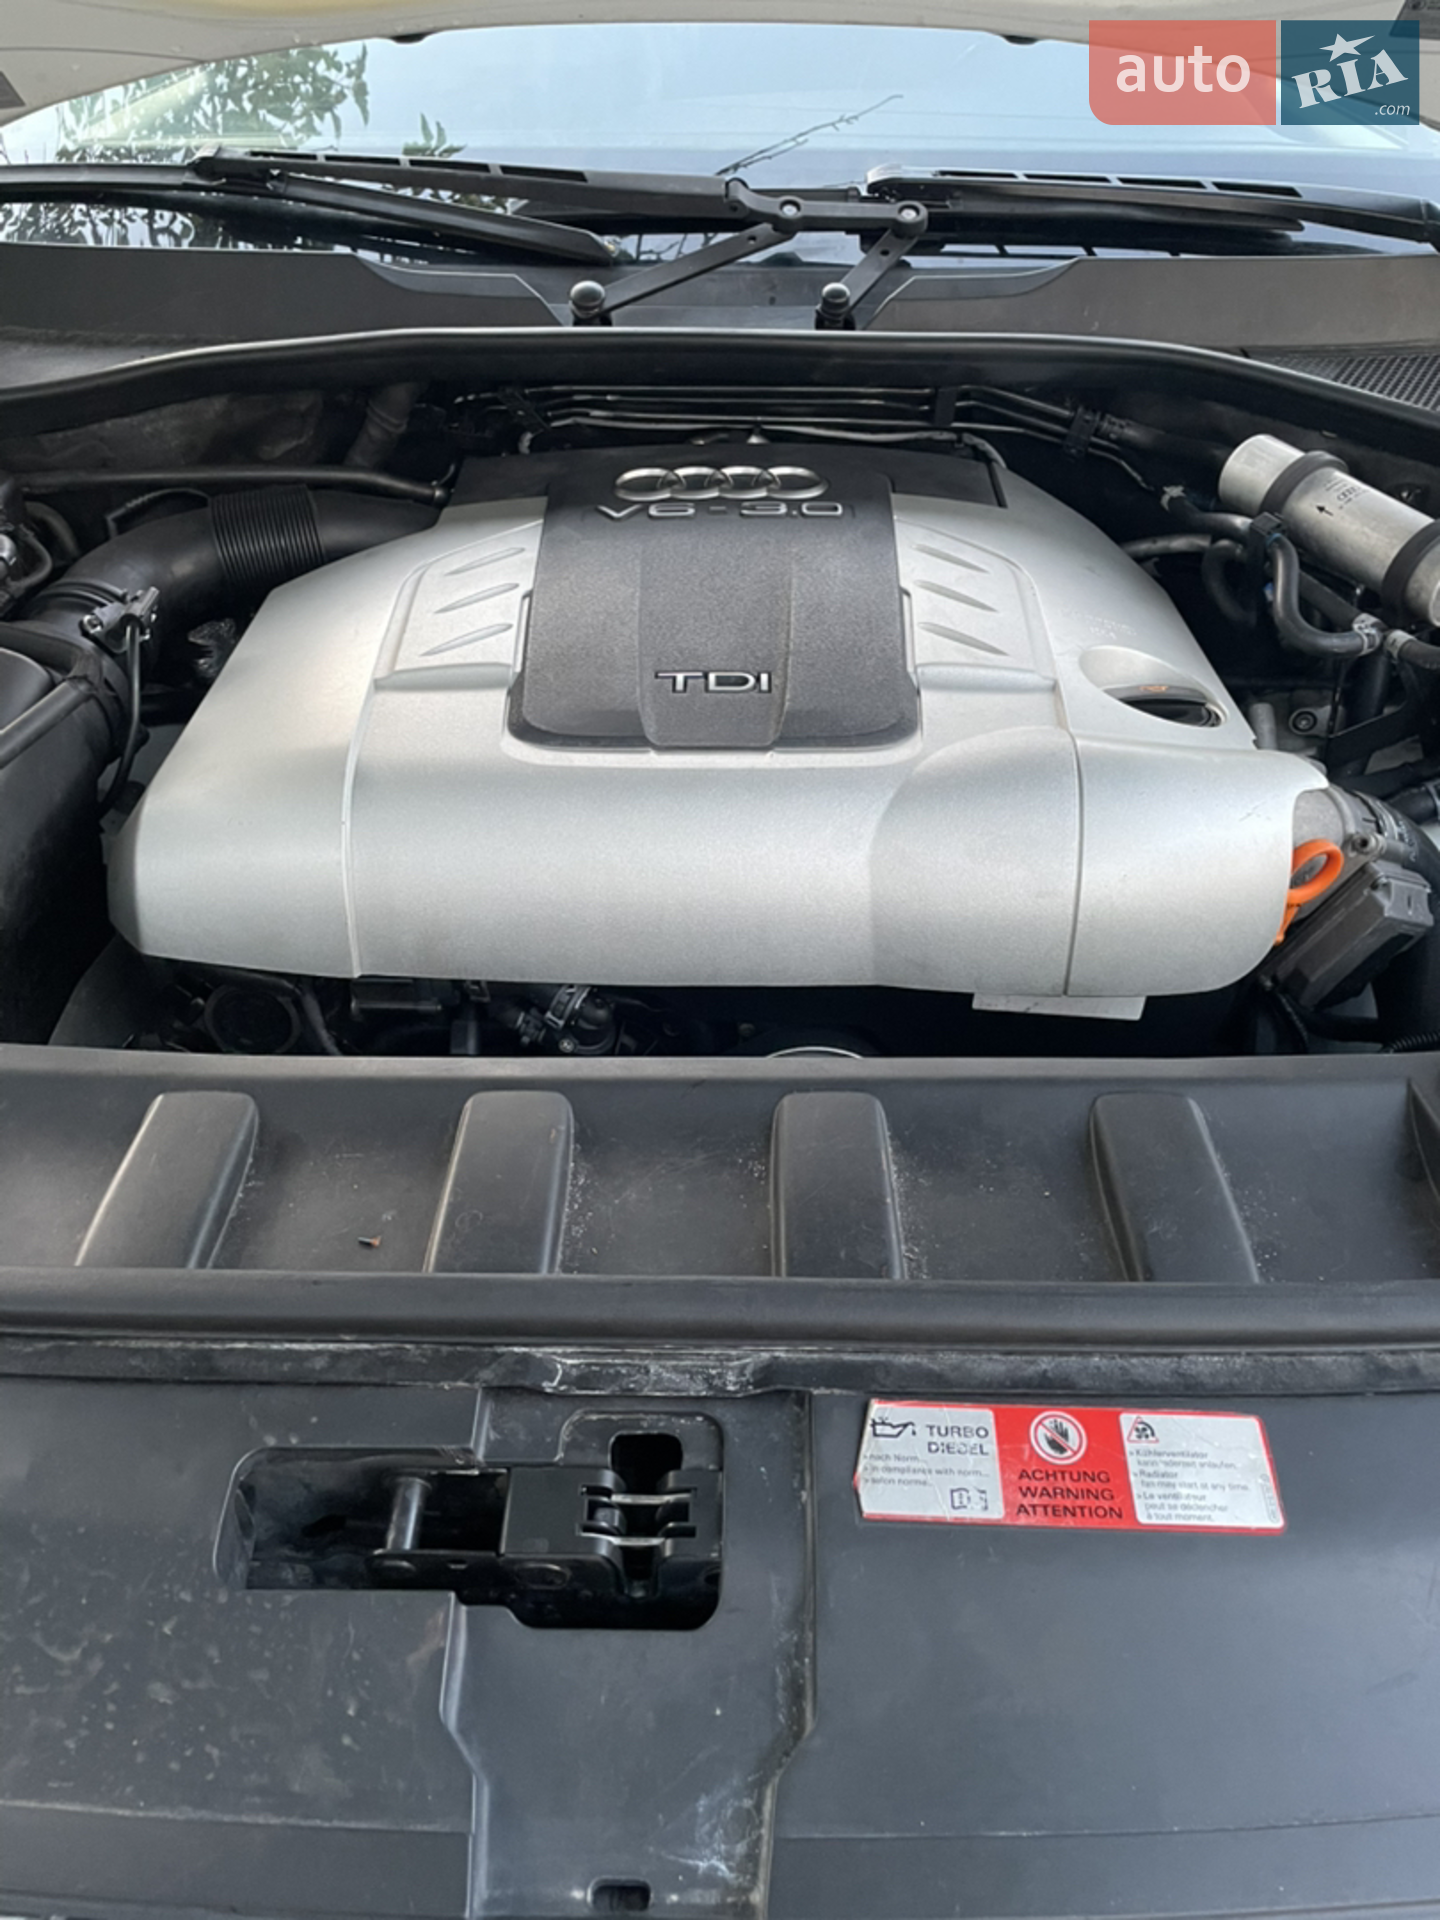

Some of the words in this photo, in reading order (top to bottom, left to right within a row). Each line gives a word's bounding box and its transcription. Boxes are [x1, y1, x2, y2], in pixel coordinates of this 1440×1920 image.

[655, 671, 772, 693] TDI
[926, 1424, 989, 1439] TURBO
[927, 1441, 989, 1456] DIESEL
[1018, 1468, 1111, 1484] ACHTUNG
[1138, 1469, 1178, 1478] Radiator
[1018, 1486, 1115, 1501] WARNING
[1016, 1503, 1123, 1519] ATTENTION
